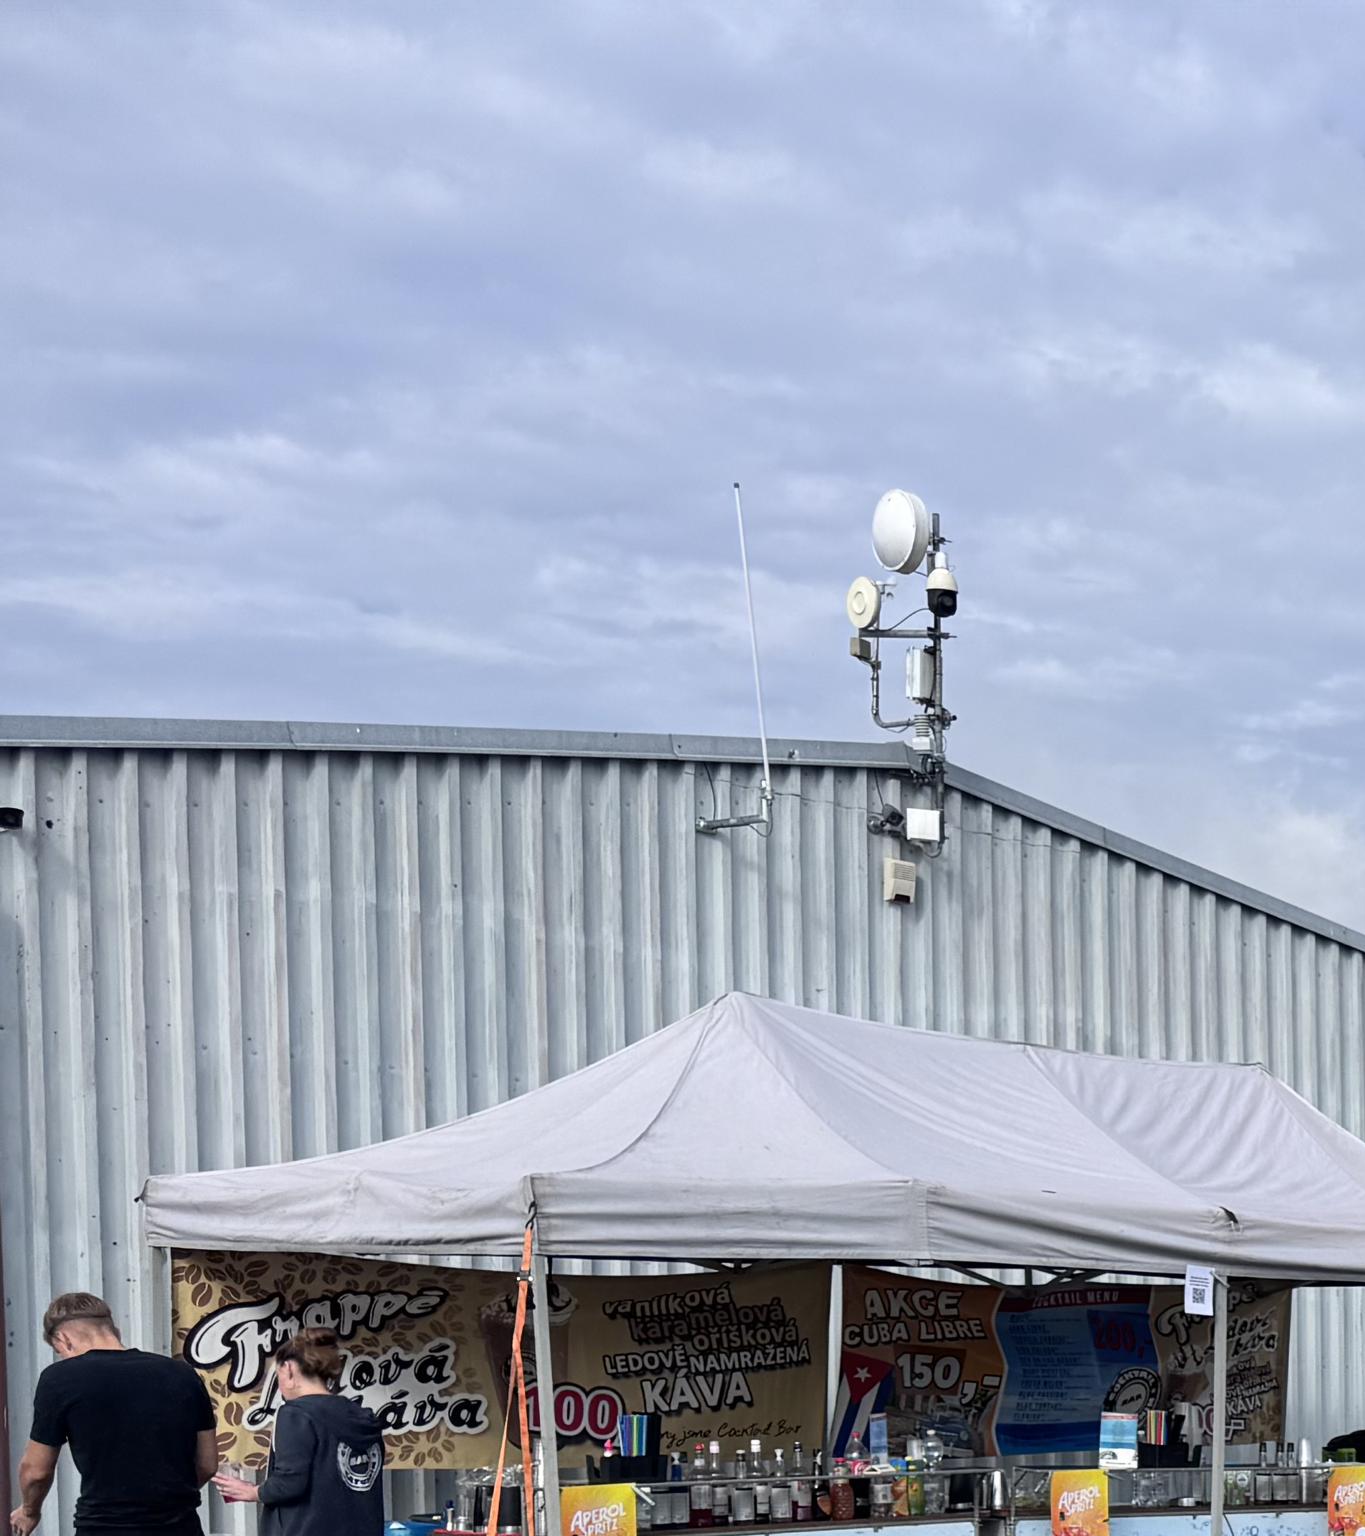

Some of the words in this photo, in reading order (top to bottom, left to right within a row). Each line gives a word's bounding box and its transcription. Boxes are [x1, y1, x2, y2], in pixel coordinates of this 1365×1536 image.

[864, 1288, 963, 1320] AKCE
[1086, 1290, 1120, 1304] MENU
[692, 1318, 798, 1352] oříšková
[843, 1321, 909, 1346] CUBA
[917, 1318, 987, 1341] LIBRE
[604, 1345, 687, 1375] LEDOVĚ
[688, 1339, 810, 1373] NAMRAŽENÁ
[247, 1343, 450, 1425] Lová
[641, 1369, 752, 1414] KÁVA
[362, 1389, 483, 1430] áva
[1058, 1486, 1101, 1511] APEROL
[570, 1502, 627, 1532] APEROL
